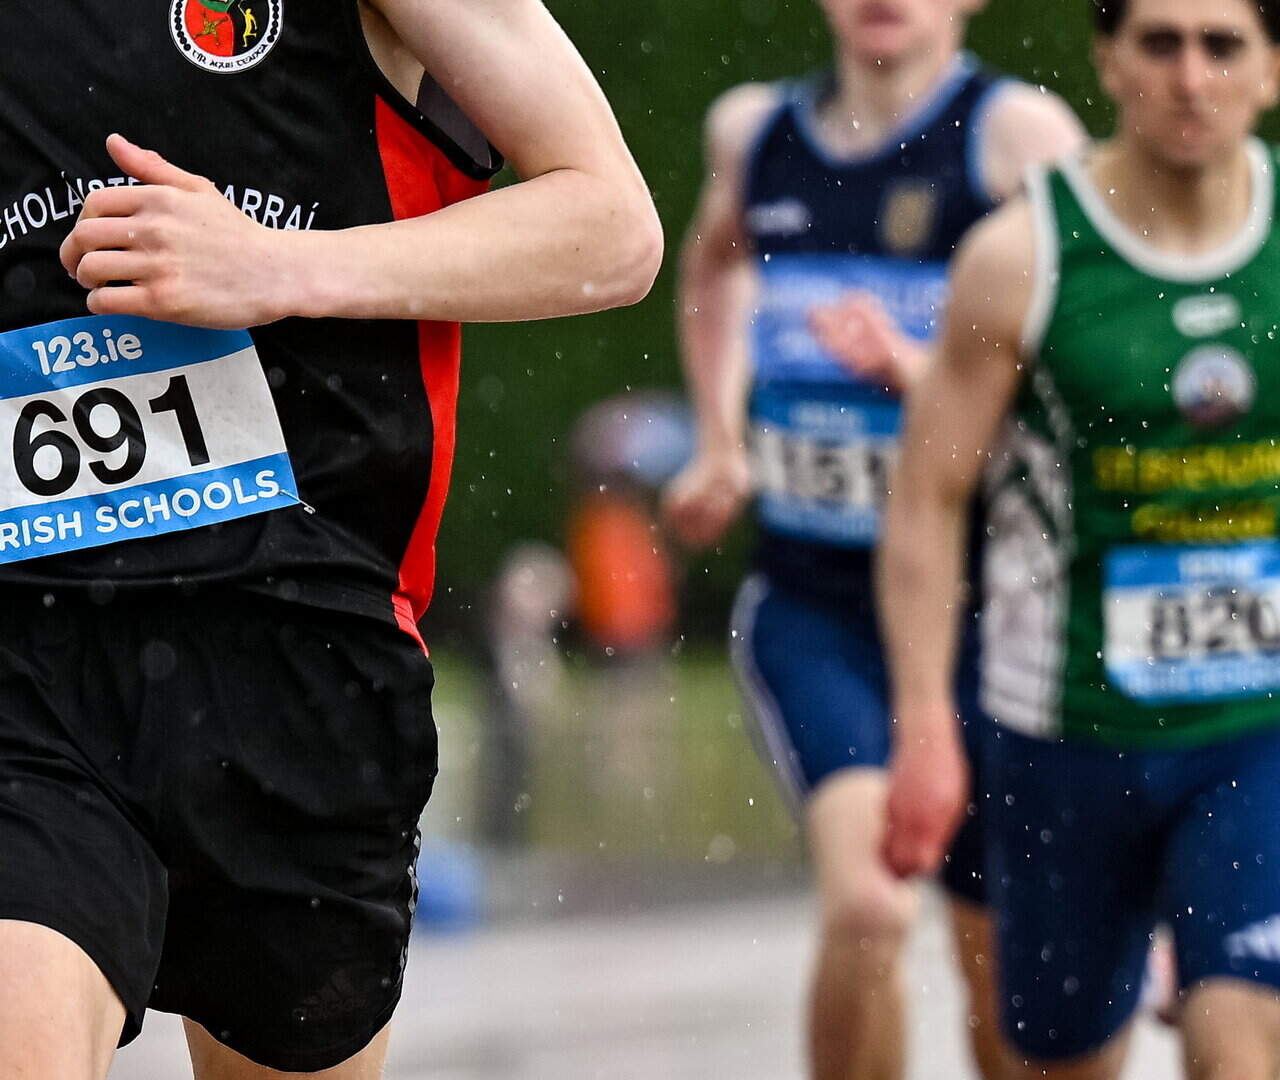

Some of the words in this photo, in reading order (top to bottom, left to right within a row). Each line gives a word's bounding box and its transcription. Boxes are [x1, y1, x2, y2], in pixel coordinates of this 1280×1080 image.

[223, 184, 320, 232] ARRAÍ
[32, 328, 143, 375] 123.ie
[12, 375, 210, 497] 691
[95, 470, 281, 533] SCHOOLS
